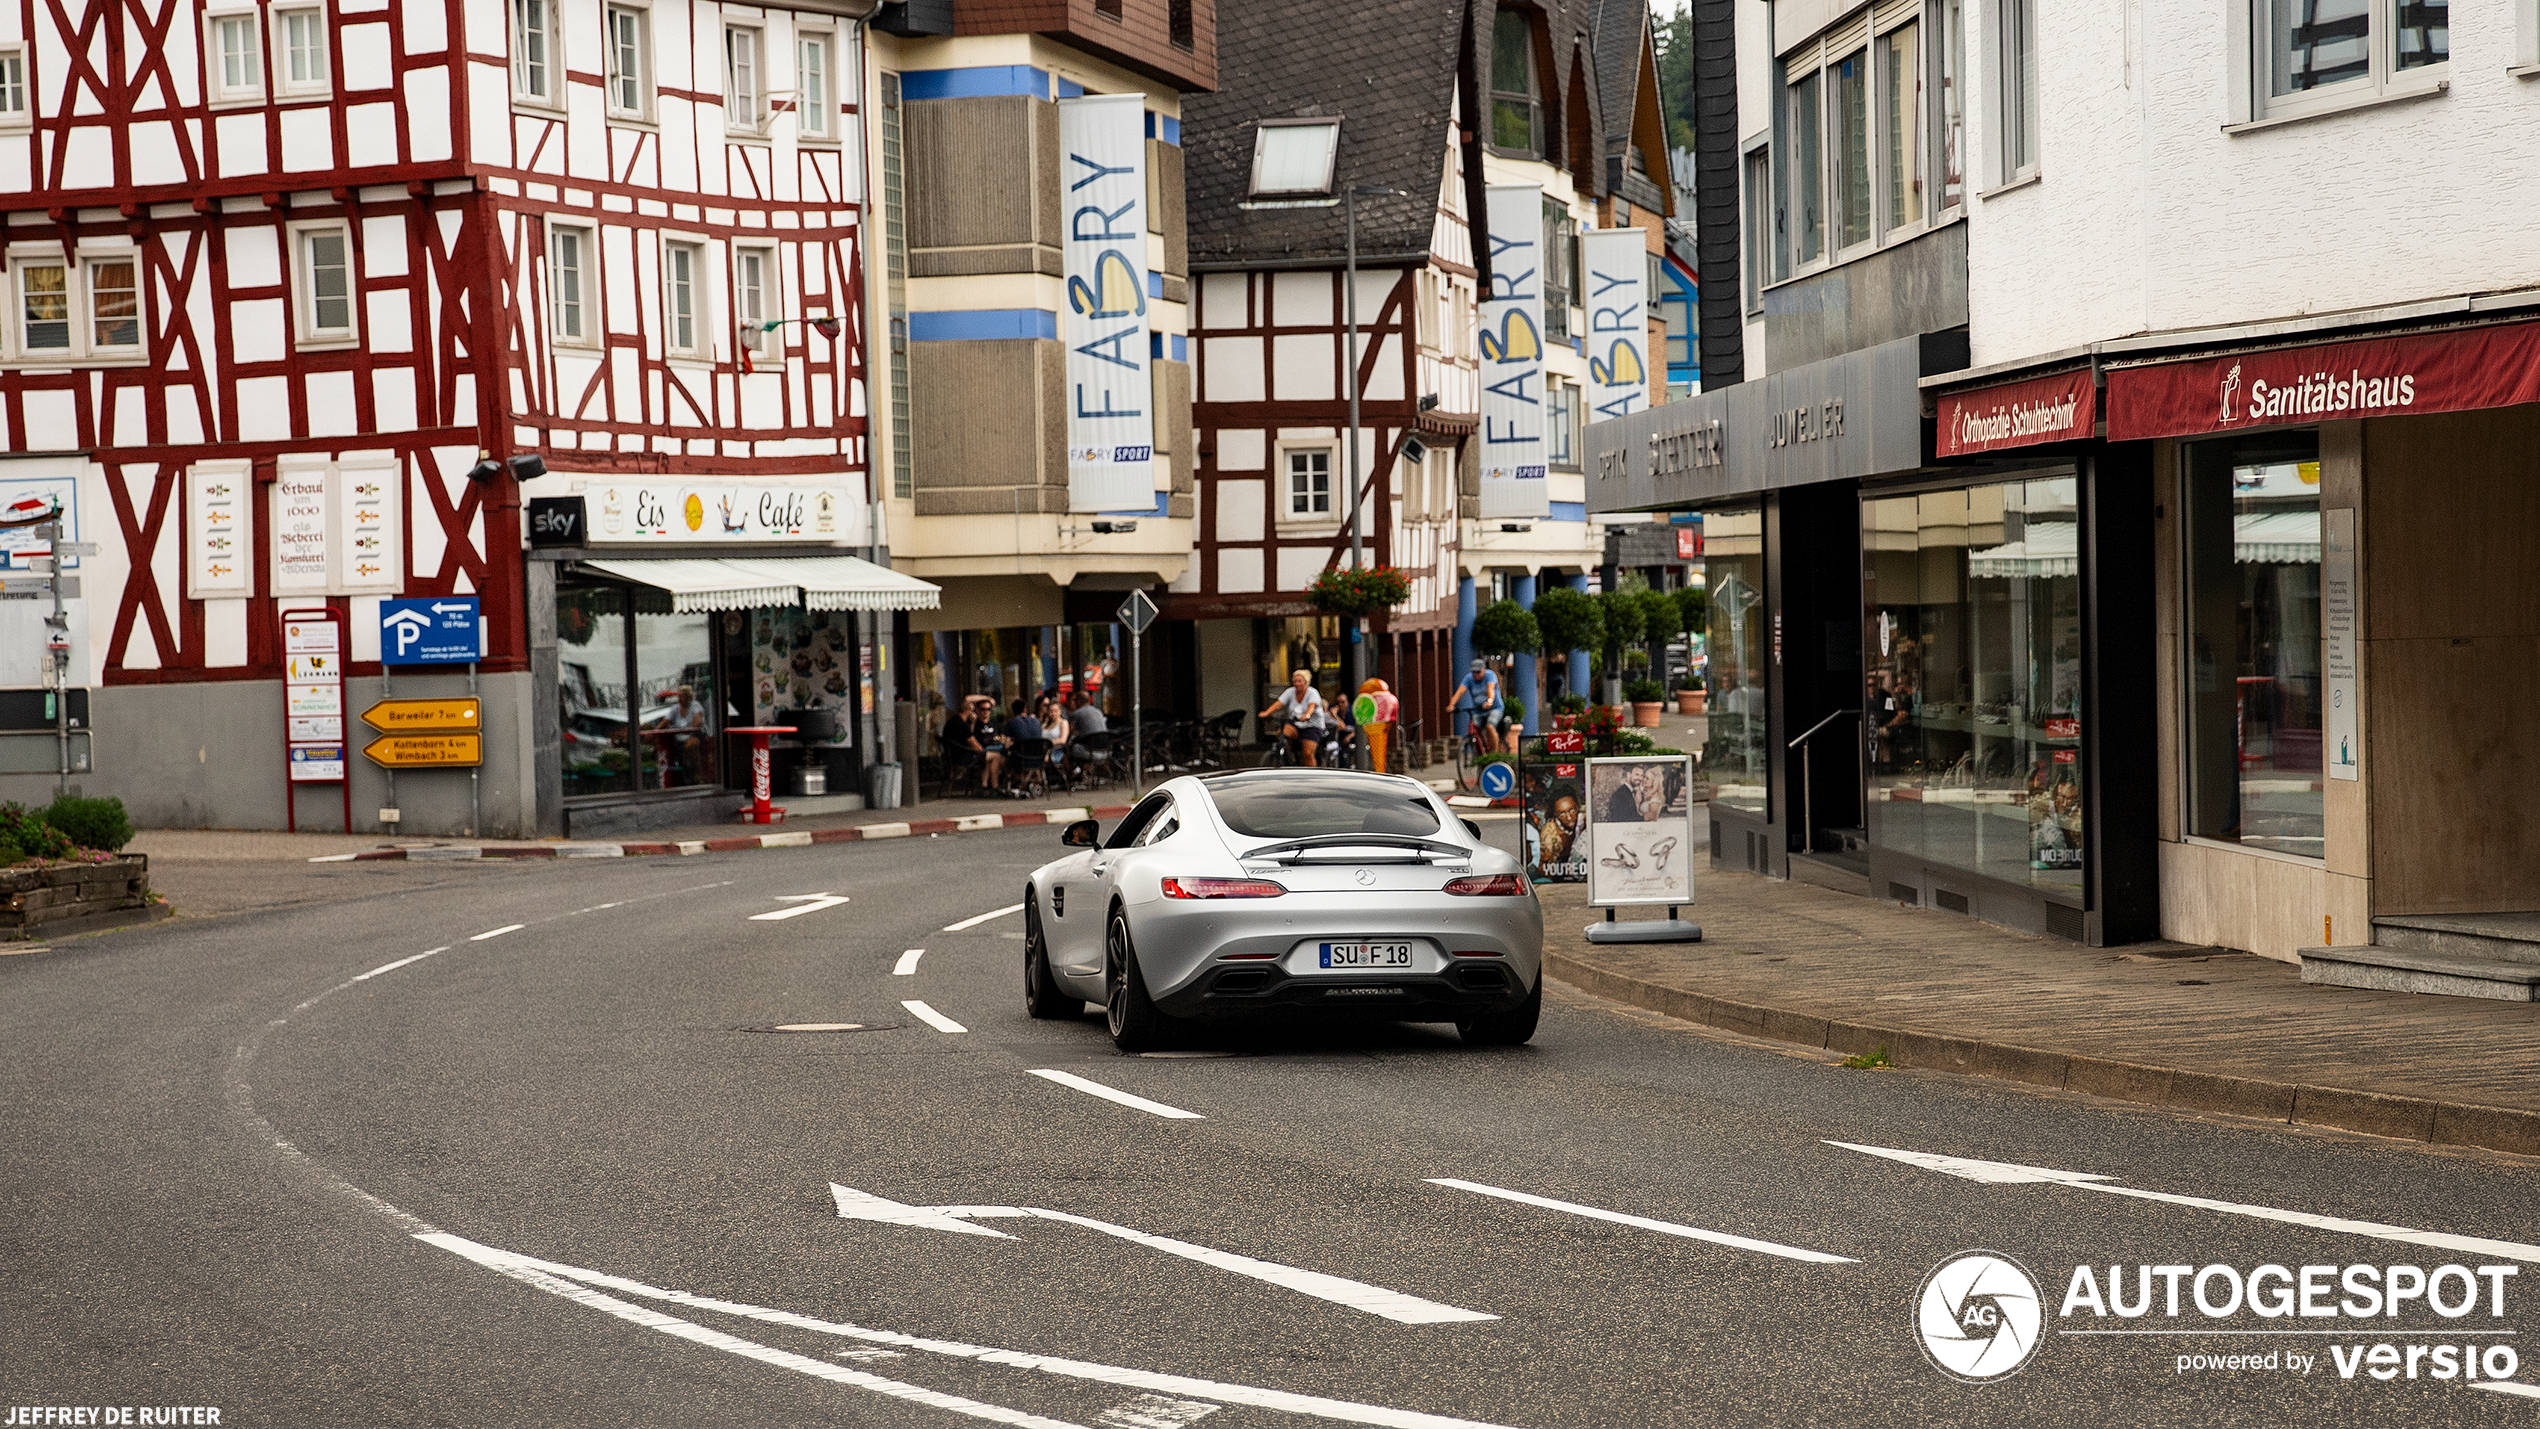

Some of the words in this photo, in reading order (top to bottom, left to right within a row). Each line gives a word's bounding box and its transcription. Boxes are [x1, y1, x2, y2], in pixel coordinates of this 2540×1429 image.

[1068, 151, 1146, 420] FABRY
[1479, 233, 1543, 445] FABRY
[1590, 269, 1645, 418] ABRY
[2249, 369, 2415, 419] Sanitätshaus
[1769, 397, 1845, 449] JUWELIER
[1962, 405, 2010, 449] Orthopädie
[1115, 446, 1149, 461] SPORT
[287, 506, 320, 516] 1000
[534, 507, 576, 536] sky
[637, 489, 665, 527] Eis
[759, 491, 804, 533] Café
[397, 621, 420, 656] P
[388, 710, 434, 721] Barweiler
[438, 709, 444, 719] 7
[394, 751, 437, 761] Wimbach
[1543, 862, 1578, 876] YOU'RE
[1579, 862, 1587, 876] O
[1333, 945, 1358, 964] SU
[1370, 945, 1382, 964] F
[1386, 945, 1408, 964] 18
